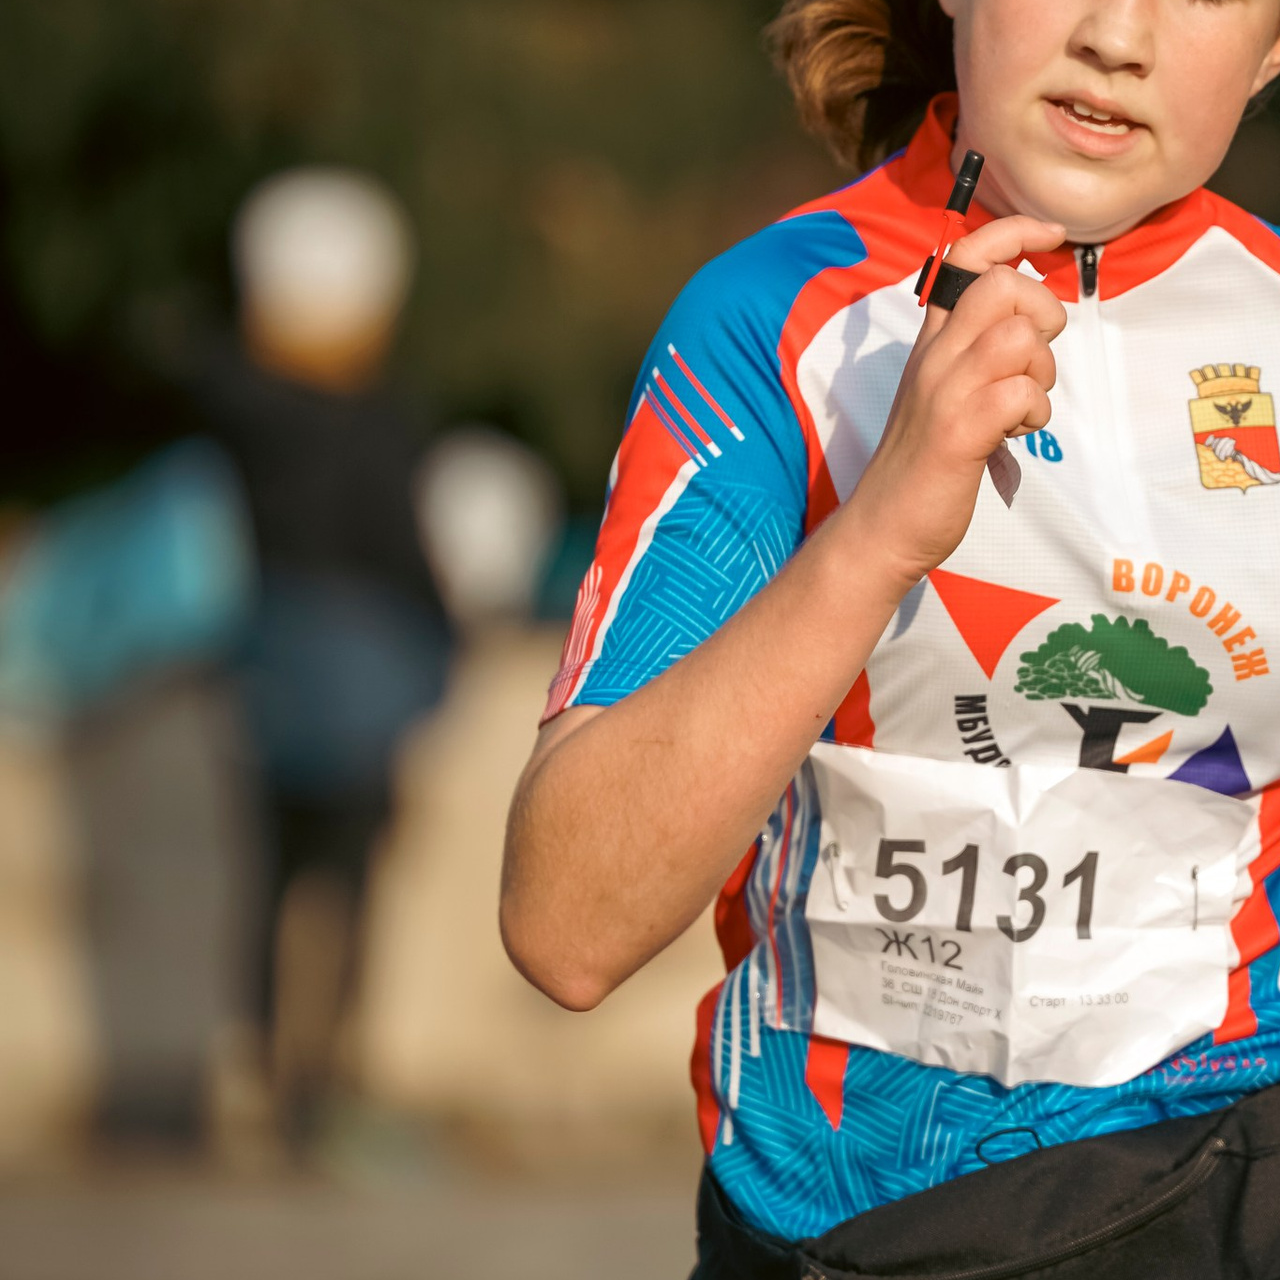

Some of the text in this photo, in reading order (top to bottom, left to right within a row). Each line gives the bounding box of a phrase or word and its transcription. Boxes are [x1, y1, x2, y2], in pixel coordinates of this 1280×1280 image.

[1112, 558, 1270, 682] ВОРОНЕЖ
[873, 838, 1100, 944] 5131
[875, 927, 963, 970] Ж12
[881, 961, 984, 996] Головинская Майя
[938, 991, 960, 1006] Дон
[962, 1000, 991, 1017] спорт
[1029, 995, 1066, 1008] Старт
